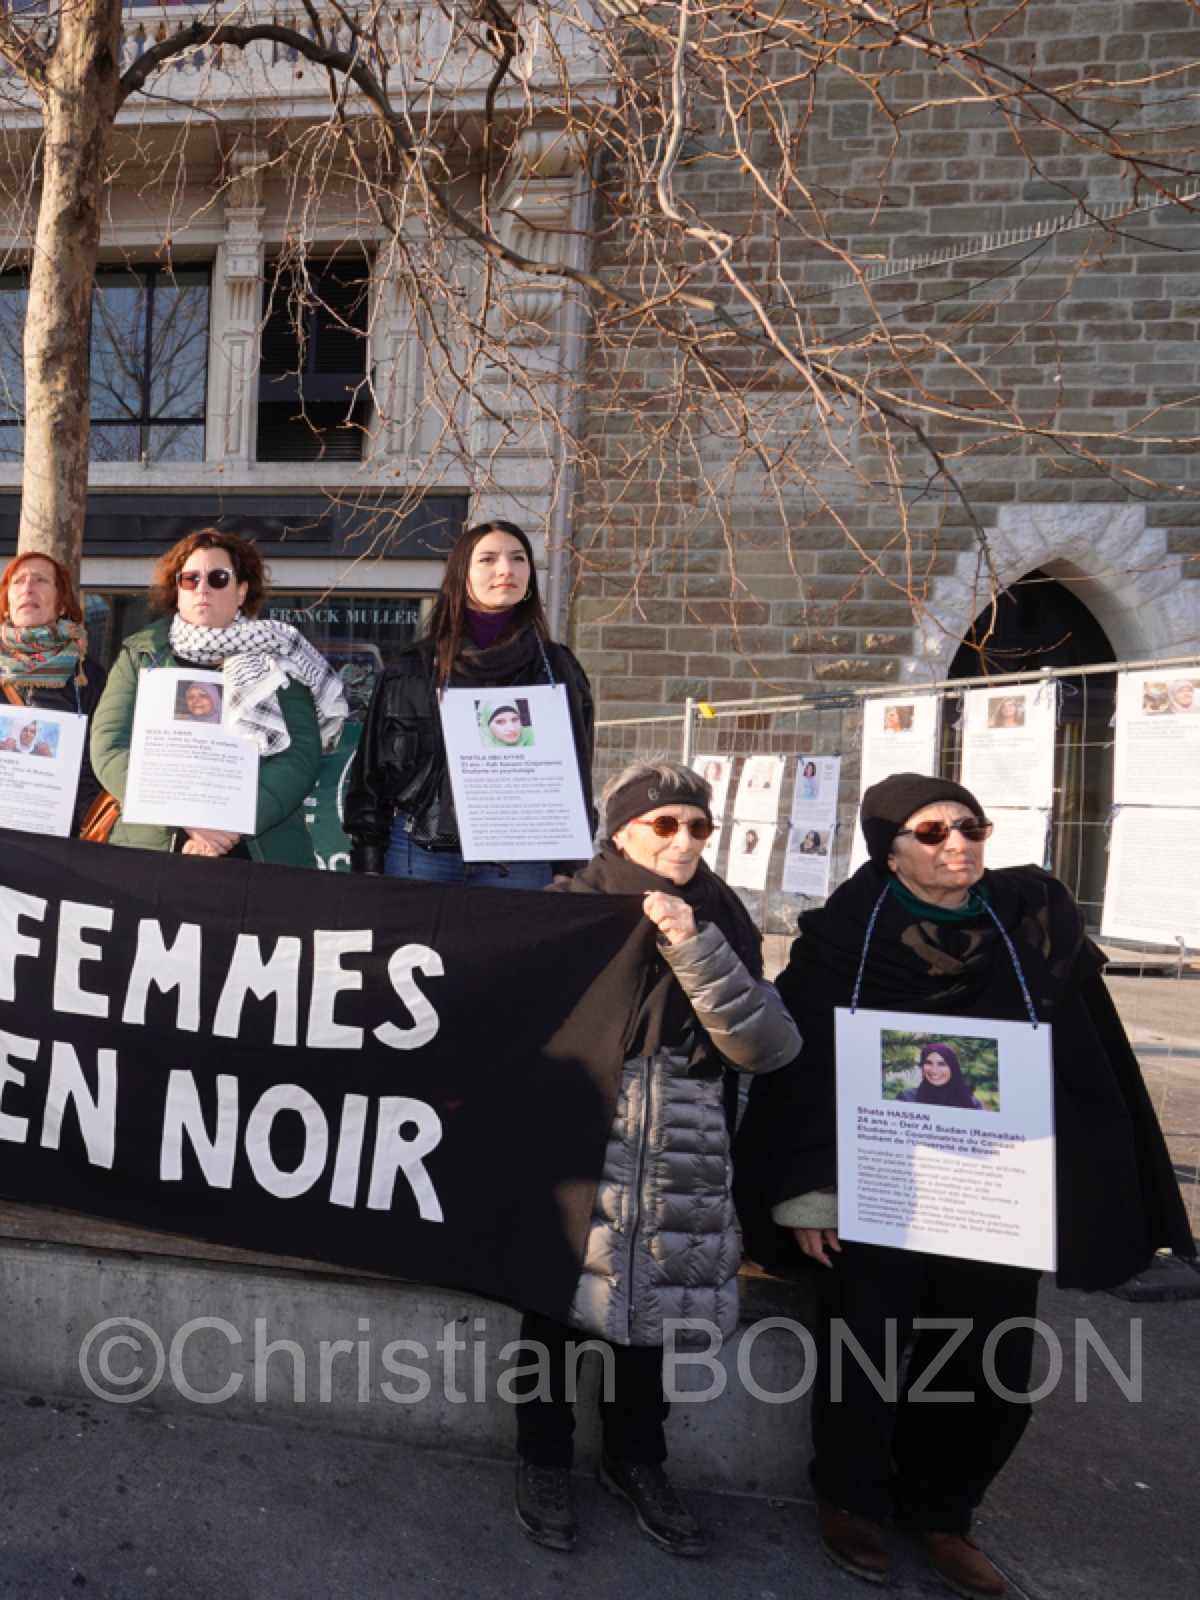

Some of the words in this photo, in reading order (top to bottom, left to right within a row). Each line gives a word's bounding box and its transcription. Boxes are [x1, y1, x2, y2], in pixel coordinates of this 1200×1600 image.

[269, 607, 340, 623] FRANCK
[347, 609, 419, 625] MULLER
[886, 1109, 931, 1121] HASSAN
[871, 1118, 889, 1127] ans
[900, 1119, 919, 1129] Deir
[935, 1124, 967, 1135] Sudan
[970, 1129, 1026, 1143] (Ramallah)
[159, 1069, 445, 1223] NOIR
